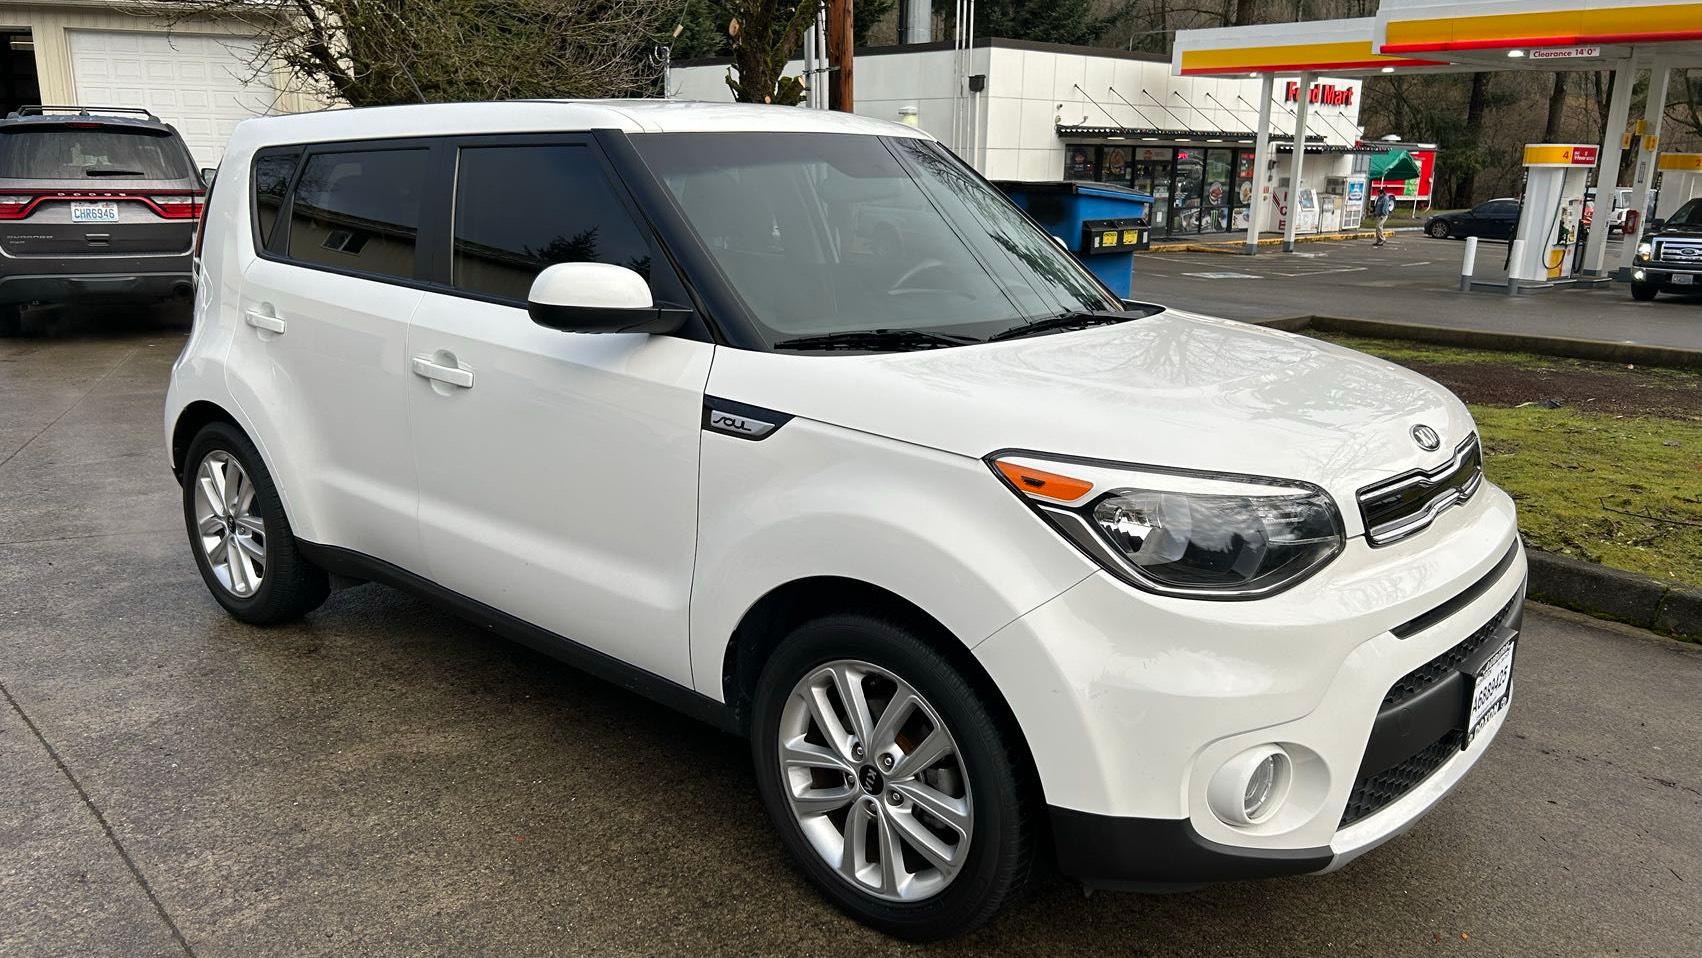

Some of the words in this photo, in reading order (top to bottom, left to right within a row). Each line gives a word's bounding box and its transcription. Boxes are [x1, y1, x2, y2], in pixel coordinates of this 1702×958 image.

[1533, 50, 1573, 58] Clearance
[1322, 84, 1353, 106] Mart
[1562, 151, 1569, 160] 4
[73, 208, 115, 219] CHR6946
[864, 768, 877, 792] KIA
